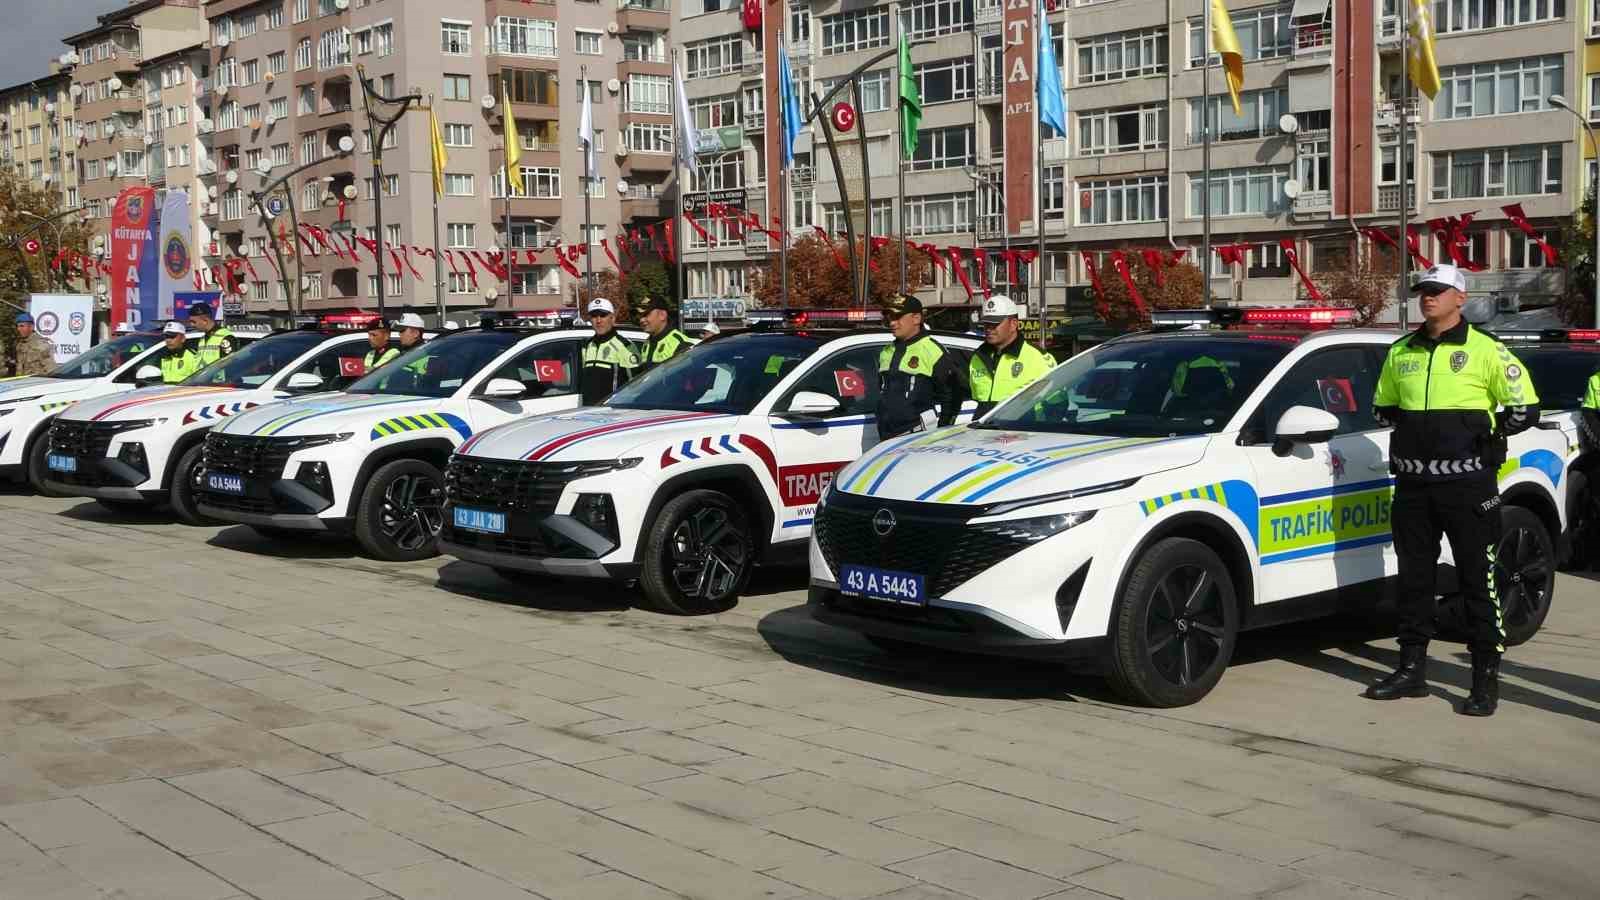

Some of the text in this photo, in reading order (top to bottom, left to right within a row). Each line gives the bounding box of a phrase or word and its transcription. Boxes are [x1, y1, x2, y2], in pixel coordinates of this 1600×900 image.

[114, 225, 152, 240] KÜTAHYA
[60, 340, 81, 354] TESCİL
[209, 476, 218, 488] 43
[1271, 505, 1334, 542] TRAFİK
[848, 570, 918, 598] 43 A 5443
